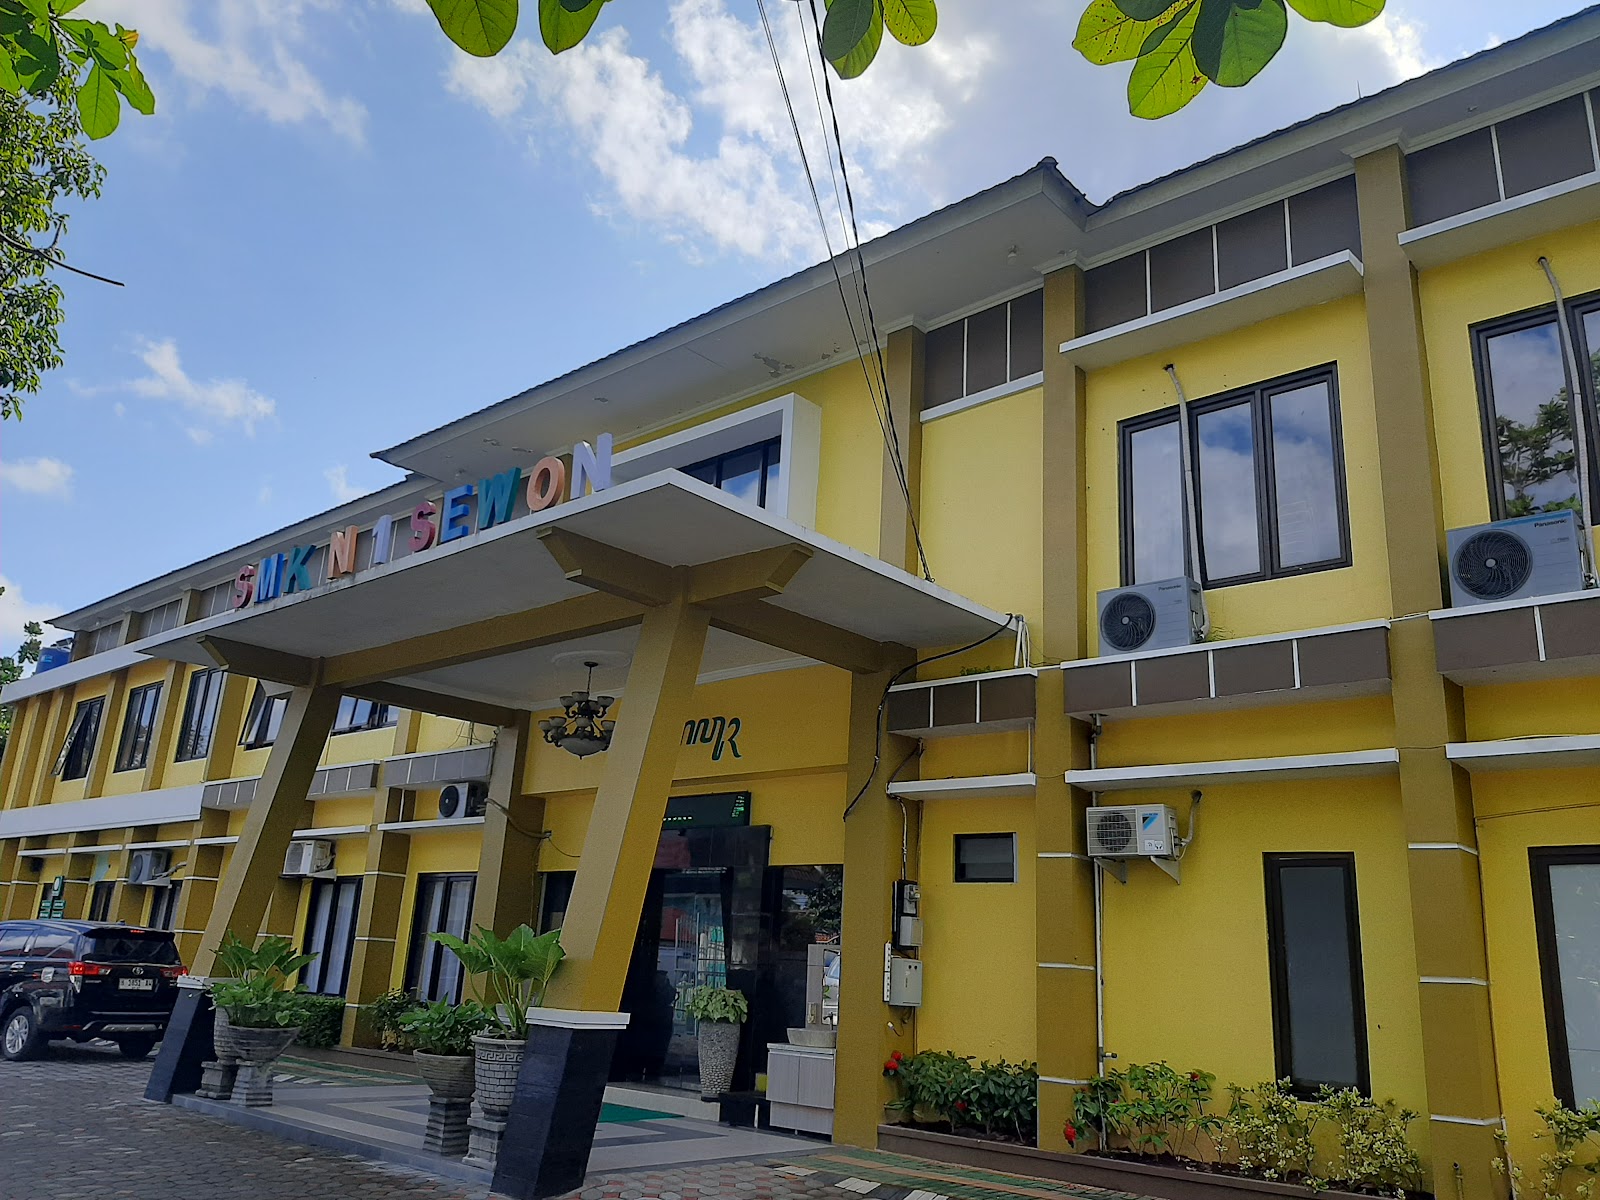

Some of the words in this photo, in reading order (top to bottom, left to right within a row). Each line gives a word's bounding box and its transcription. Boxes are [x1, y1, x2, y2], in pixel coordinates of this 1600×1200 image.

[231, 544, 316, 609] SMK
[327, 524, 358, 580] N
[371, 514, 392, 565] 1
[408, 432, 613, 553] SEWON
[1534, 519, 1567, 528] Panasonic
